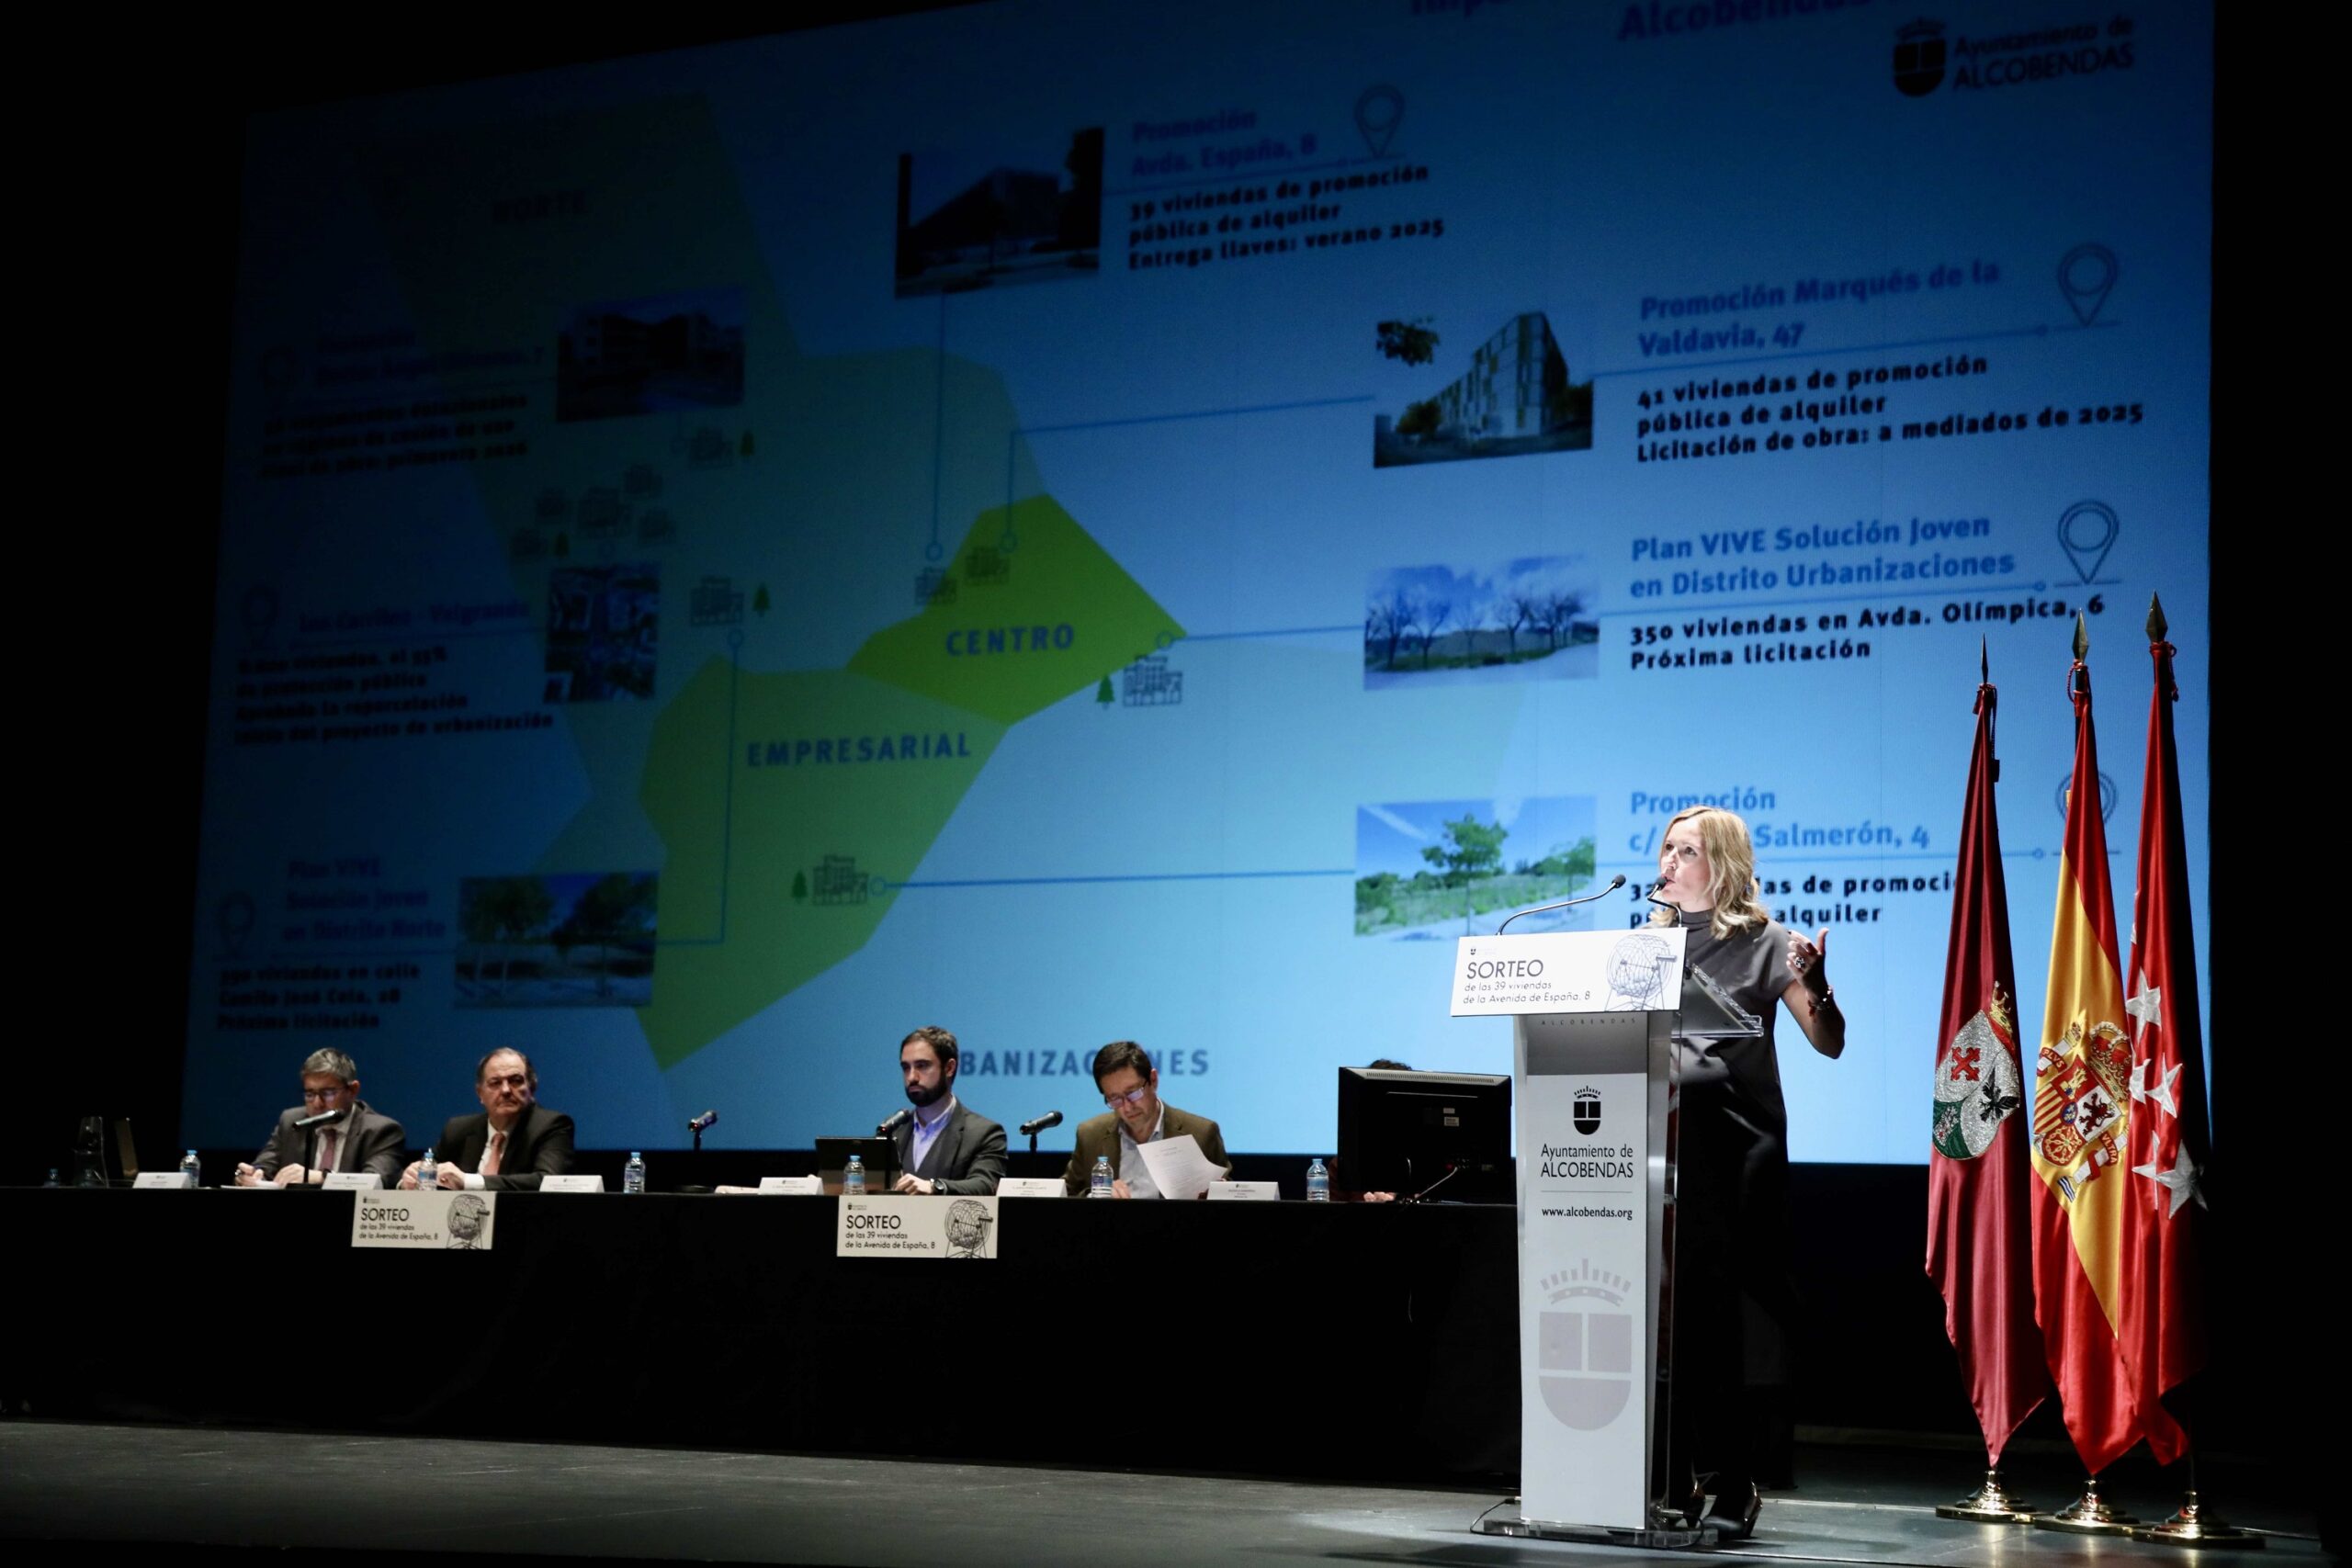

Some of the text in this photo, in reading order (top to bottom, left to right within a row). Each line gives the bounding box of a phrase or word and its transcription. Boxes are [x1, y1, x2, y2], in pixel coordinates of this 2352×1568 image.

[1954, 16, 2133, 57] Ayuntamiento de
[1953, 42, 2133, 90] ALCOBENDAS
[1133, 108, 1257, 143] Promoción
[1133, 151, 1193, 176] Avda.
[1131, 165, 1429, 221] 39 viviendas de promoción
[1129, 204, 1340, 247] pública de alquiler
[1129, 218, 1444, 270] Entrega llaves: verano 2025
[1641, 258, 1999, 320] Promoción Marqués de la
[1639, 322, 1804, 356] Valdavia, 47
[1638, 355, 1987, 410] 41 viviendas de promoción
[1637, 395, 1885, 439] pública de alquiler
[1637, 403, 2143, 462] Licitación de obra: a mediados de 2025
[1632, 517, 1990, 561] Plan VIVE Solución Joven
[1631, 553, 2015, 597] en Distrito Urbanizaciones
[1631, 593, 2104, 647] 350 viviendas en Avda. Olímpica, 6
[945, 624, 1074, 656] CENTRO
[1631, 638, 1871, 670] Próxima licitación
[433, 712, 553, 734] urbanización
[748, 732, 970, 768] EMPRESARIAL
[1631, 786, 1776, 814] Promoción
[1753, 820, 1902, 848] Salmerón,
[1911, 825, 1928, 849] 4
[1803, 875, 1832, 895] de
[1843, 871, 1956, 897] promoci
[1775, 904, 1881, 928] alquiler
[1466, 959, 1544, 980] SORTEO
[1464, 981, 1552, 992] de las 39 viviendas
[1464, 990, 1590, 1004] de la Avenida de España, 8
[1541, 1016, 1636, 1026] ALCOBENDAS
[2041, 1047, 2064, 1068] PLVS
[1541, 1143, 1634, 1162] Ayuntamiento de
[2102, 1133, 2118, 1164] VLTRA
[1541, 1161, 1634, 1179] ALCOBENDAS
[360, 1207, 410, 1222] SORTEO
[846, 1214, 901, 1230] SORTEO
[1542, 1206, 1633, 1221] www.alcobendas.org
[845, 1241, 854, 1249] de
[855, 1241, 862, 1249] la
[902, 1241, 929, 1251] España,
[931, 1242, 935, 1250] 8
